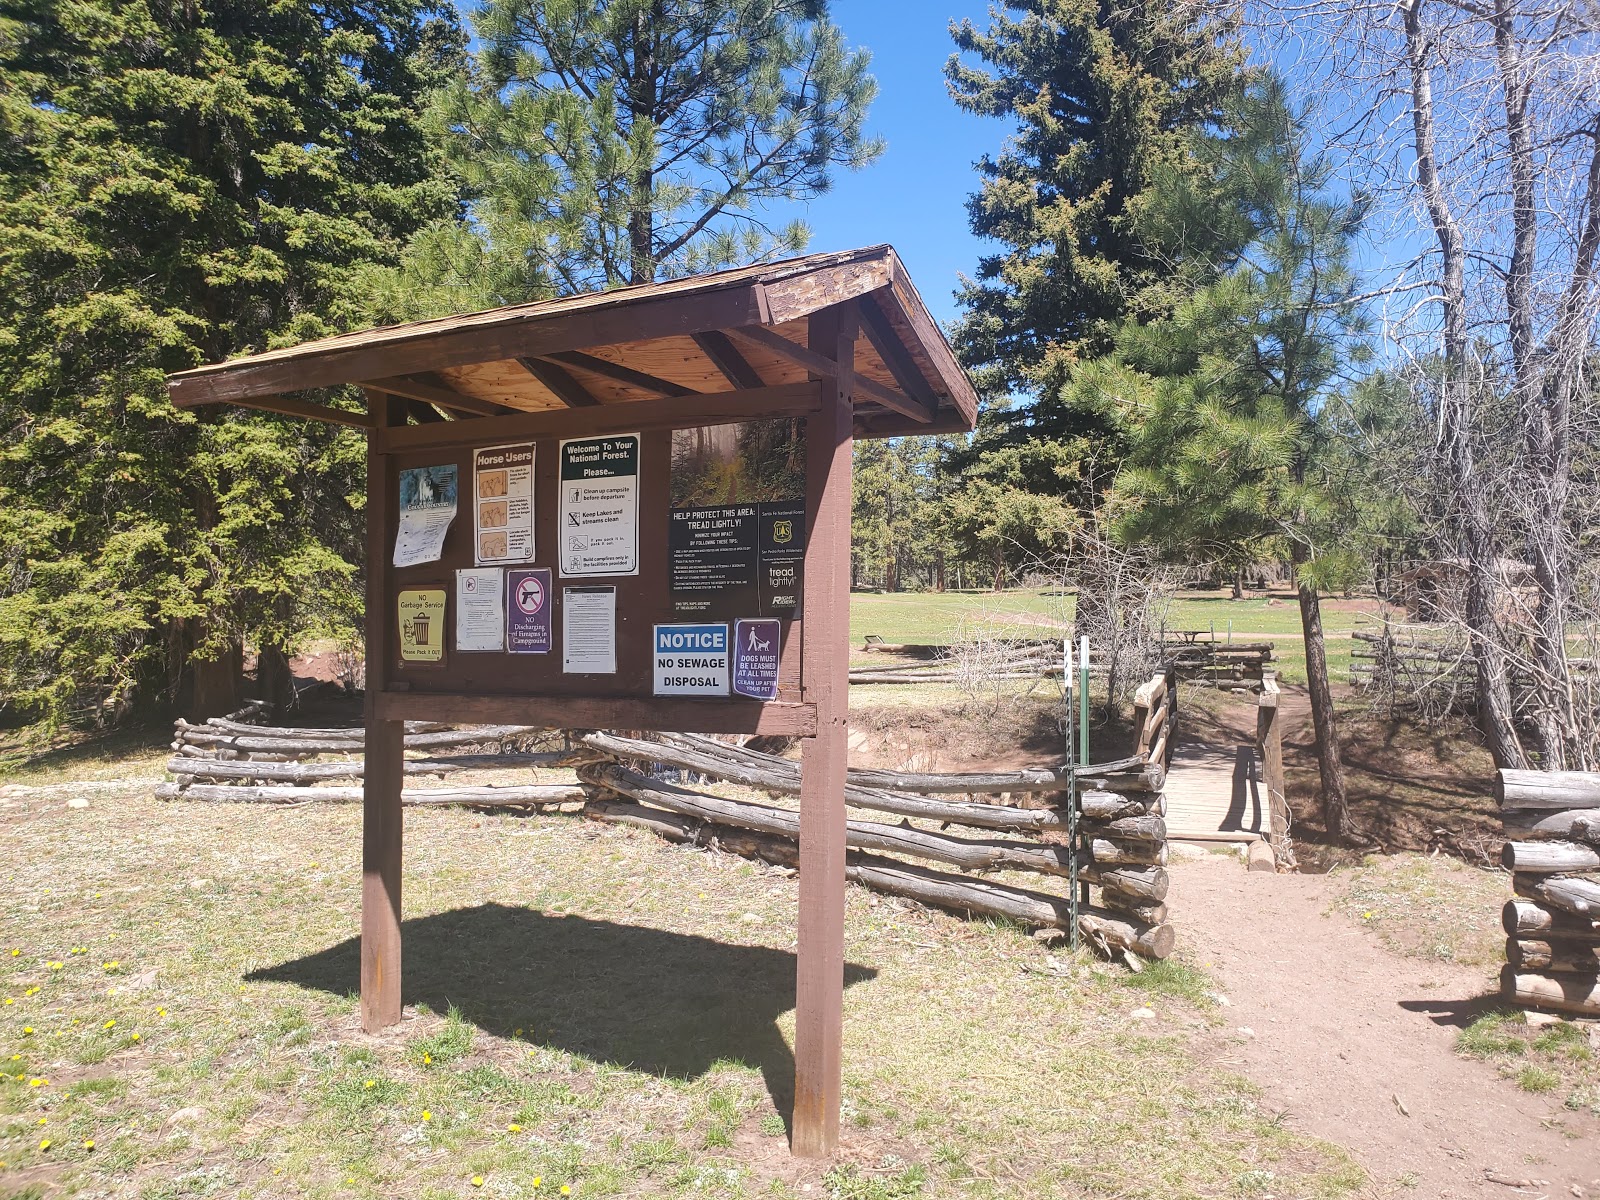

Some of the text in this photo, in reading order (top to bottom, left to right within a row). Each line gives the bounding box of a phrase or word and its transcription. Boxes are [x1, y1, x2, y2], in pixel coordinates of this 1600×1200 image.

[567, 441, 633, 455] Welcome To Your
[478, 452, 532, 466] Horse Users
[569, 450, 630, 464] National Forest.
[673, 508, 756, 520] HELP PROTECT THIS AREA:
[688, 519, 742, 530] TREAD LIGHTLY!
[769, 567, 794, 577] tread
[660, 633, 724, 648] NOTICE
[658, 658, 725, 669] NO SEWAGE
[664, 677, 720, 687] DISPOSAL
